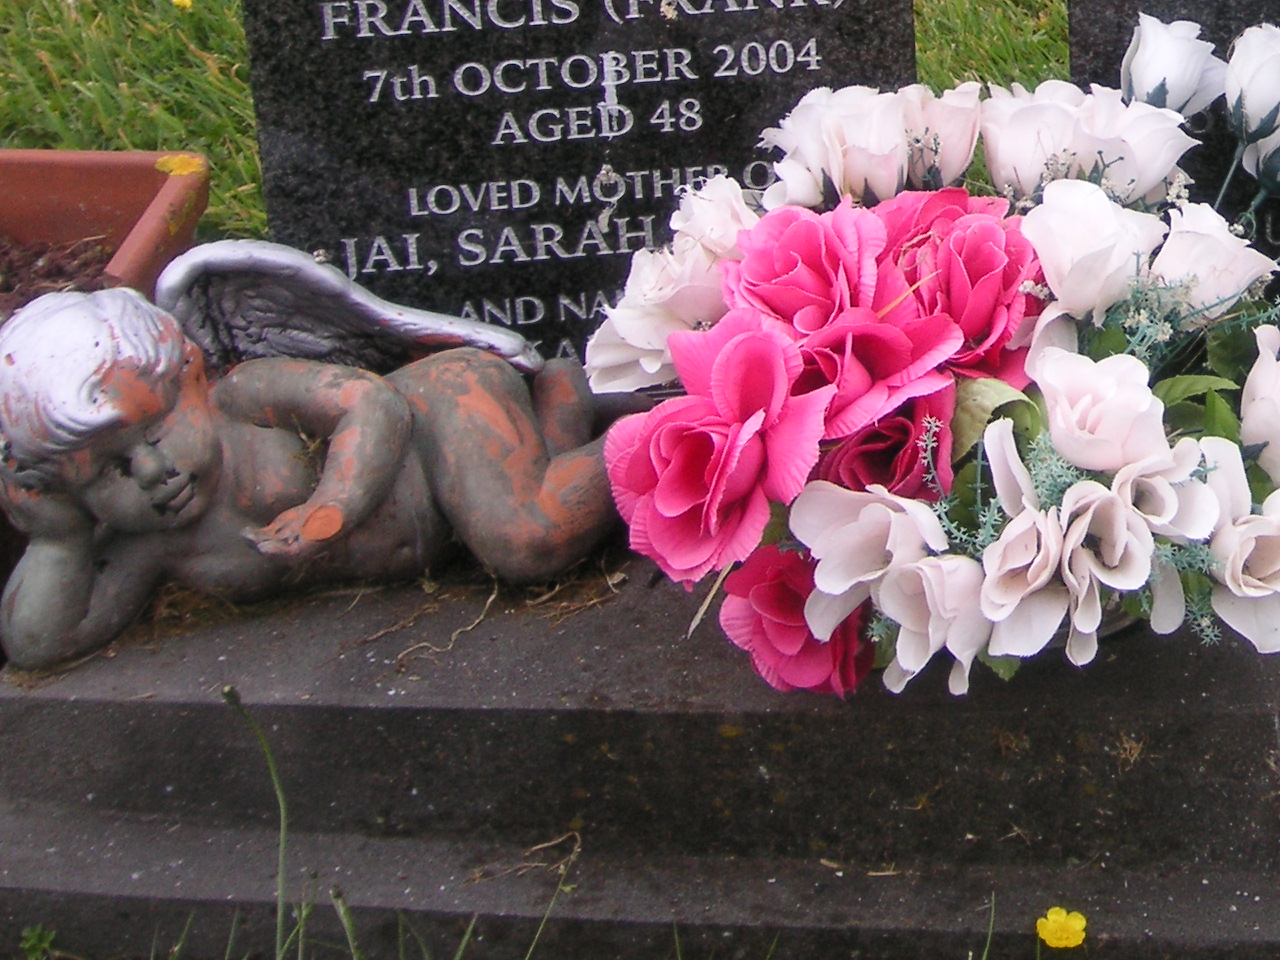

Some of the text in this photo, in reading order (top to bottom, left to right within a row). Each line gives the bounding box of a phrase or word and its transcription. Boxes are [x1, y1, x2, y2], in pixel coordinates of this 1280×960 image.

[362, 38, 822, 104] 7th OCTOBER 2004
[491, 97, 703, 146] AGED 48
[408, 179, 541, 217] LOVED
[742, 160, 777, 190] O
[340, 214, 656, 281] JAI, SARAH
[460, 295, 546, 326] AND
